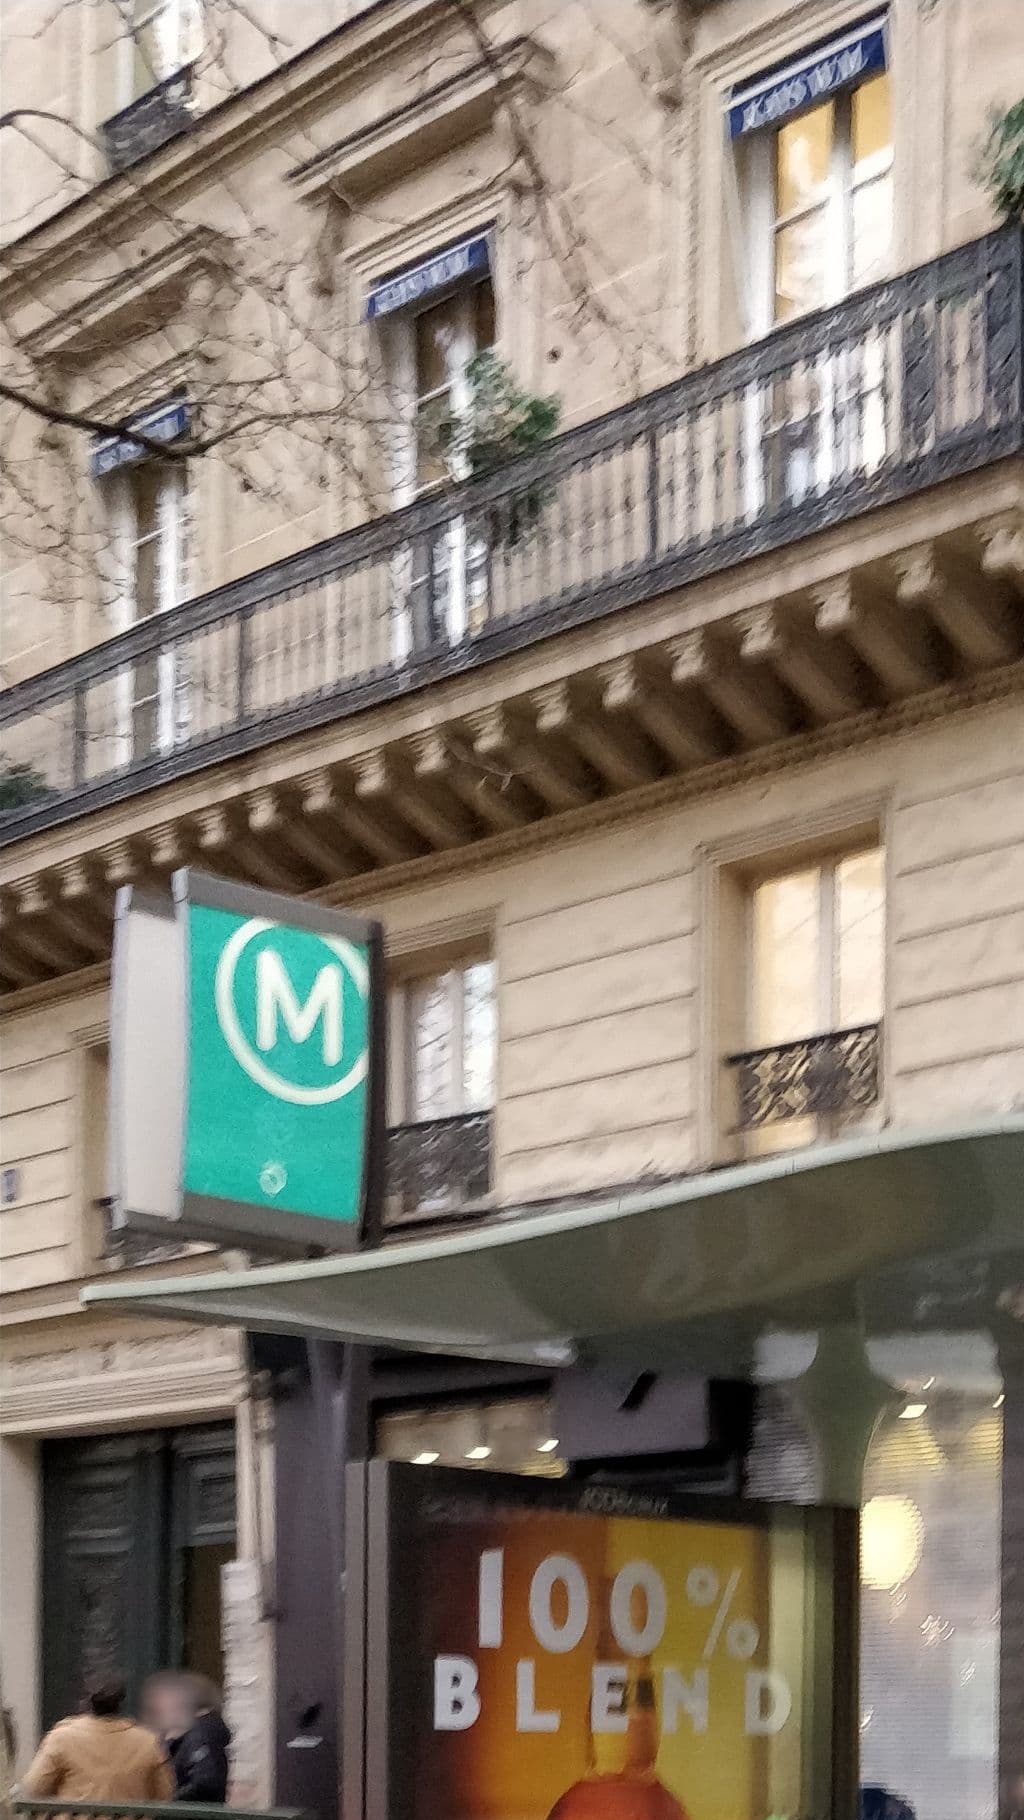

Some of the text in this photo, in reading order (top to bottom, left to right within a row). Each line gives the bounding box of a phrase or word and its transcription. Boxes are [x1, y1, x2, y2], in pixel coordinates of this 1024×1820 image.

[256, 947, 345, 1067] M
[478, 1546, 760, 1661] 100%
[434, 1653, 793, 1735] BLEND
